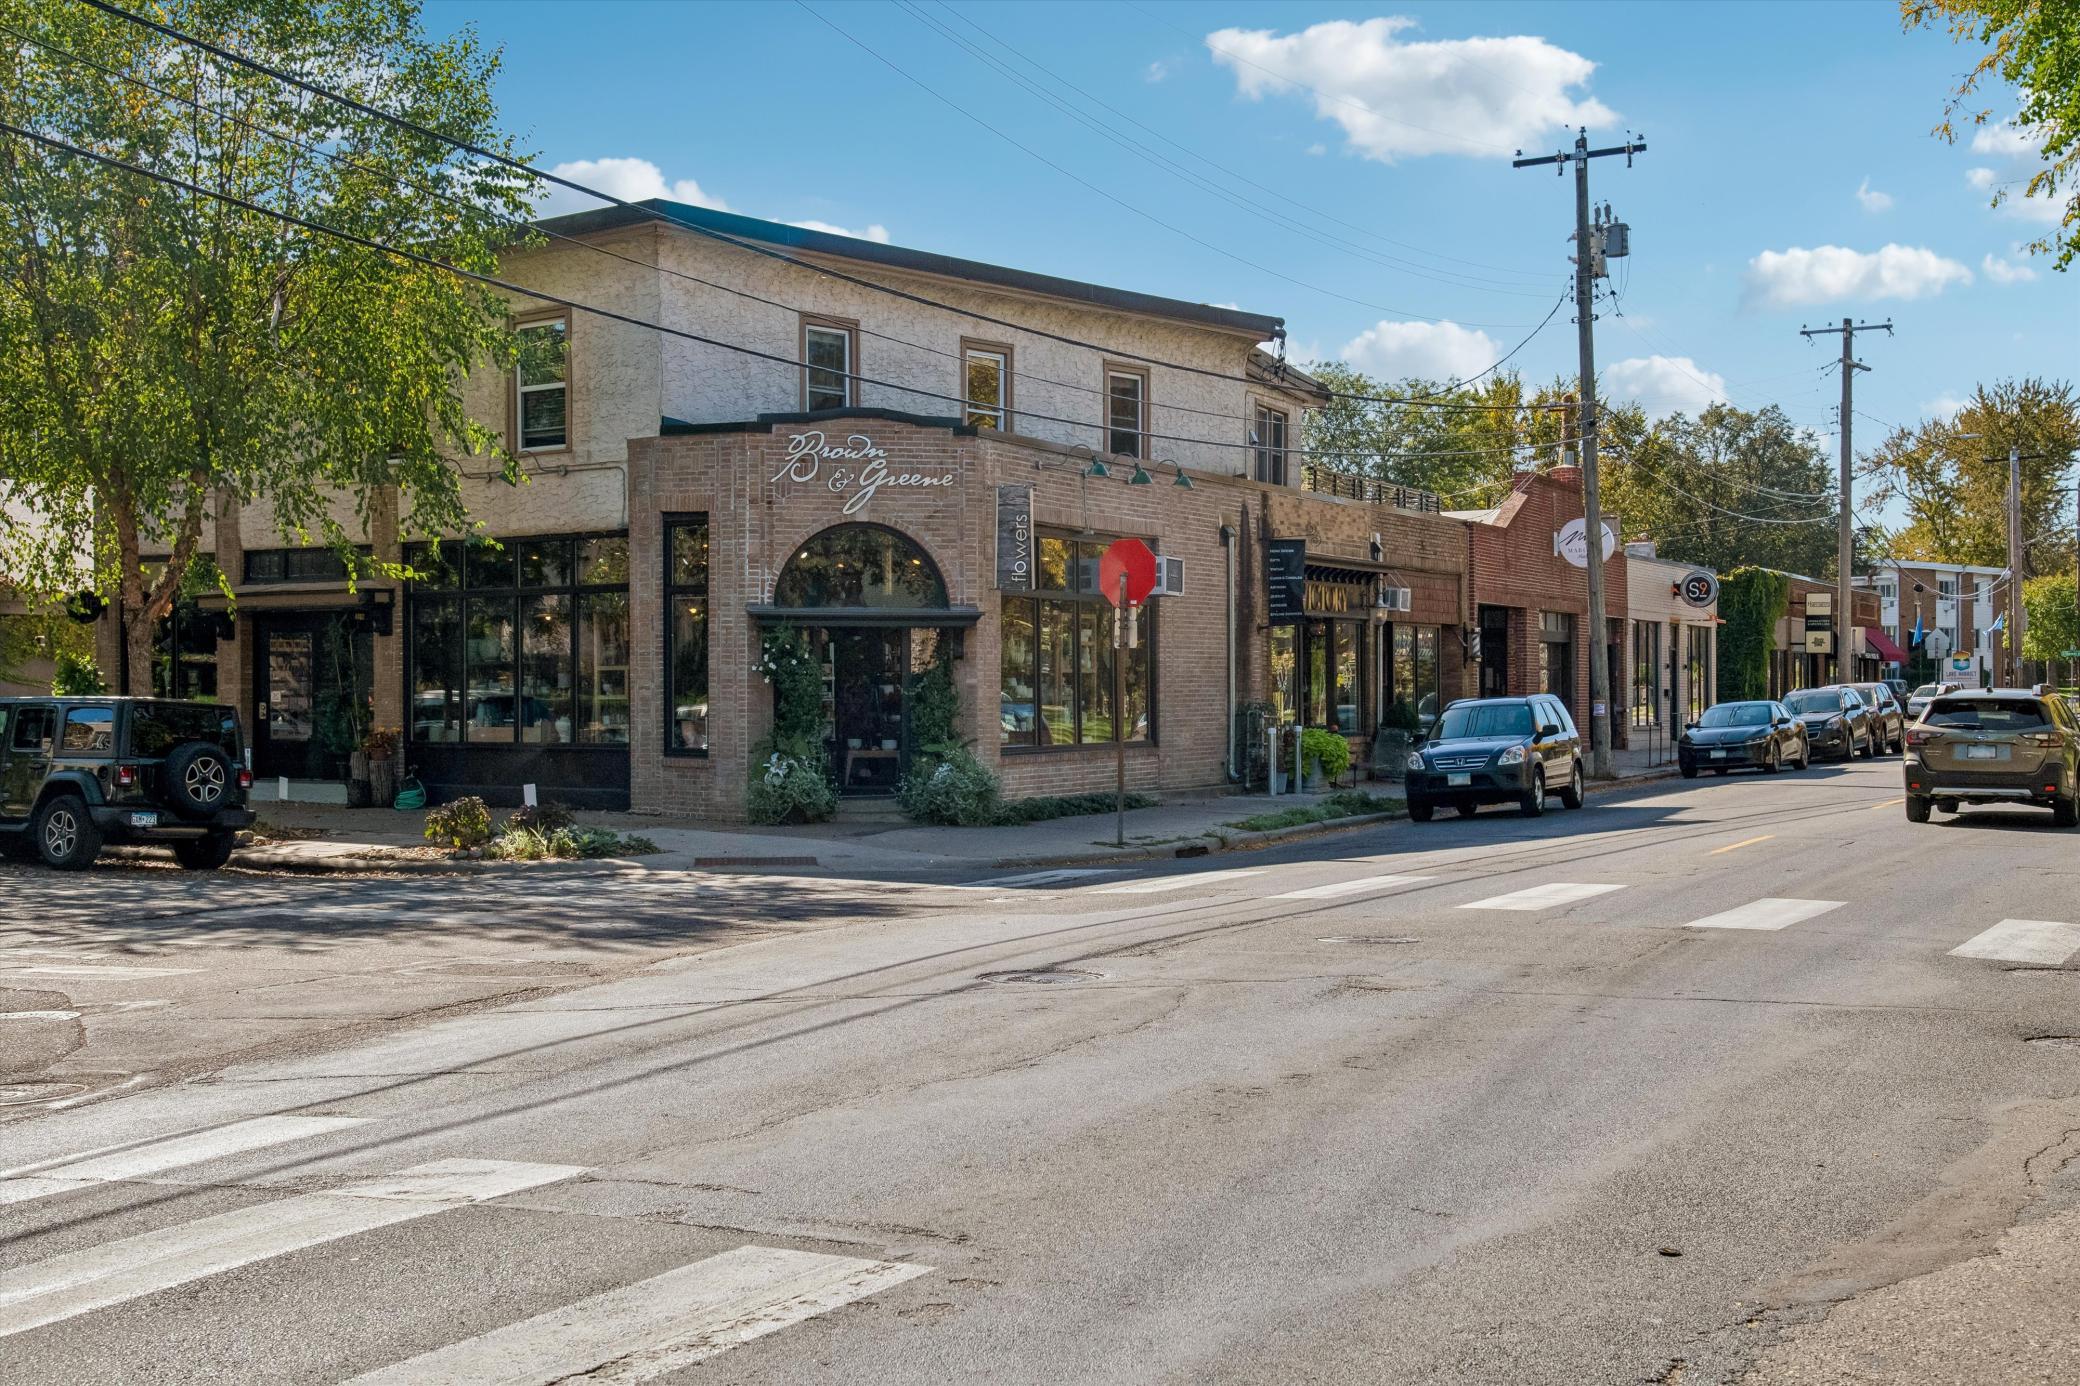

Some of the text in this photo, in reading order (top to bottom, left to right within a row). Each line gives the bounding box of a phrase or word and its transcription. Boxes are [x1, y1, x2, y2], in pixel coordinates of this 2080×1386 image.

[771, 430, 889, 483] Brown
[828, 458, 954, 515] & Greene
[1012, 514, 1028, 582] flowers
